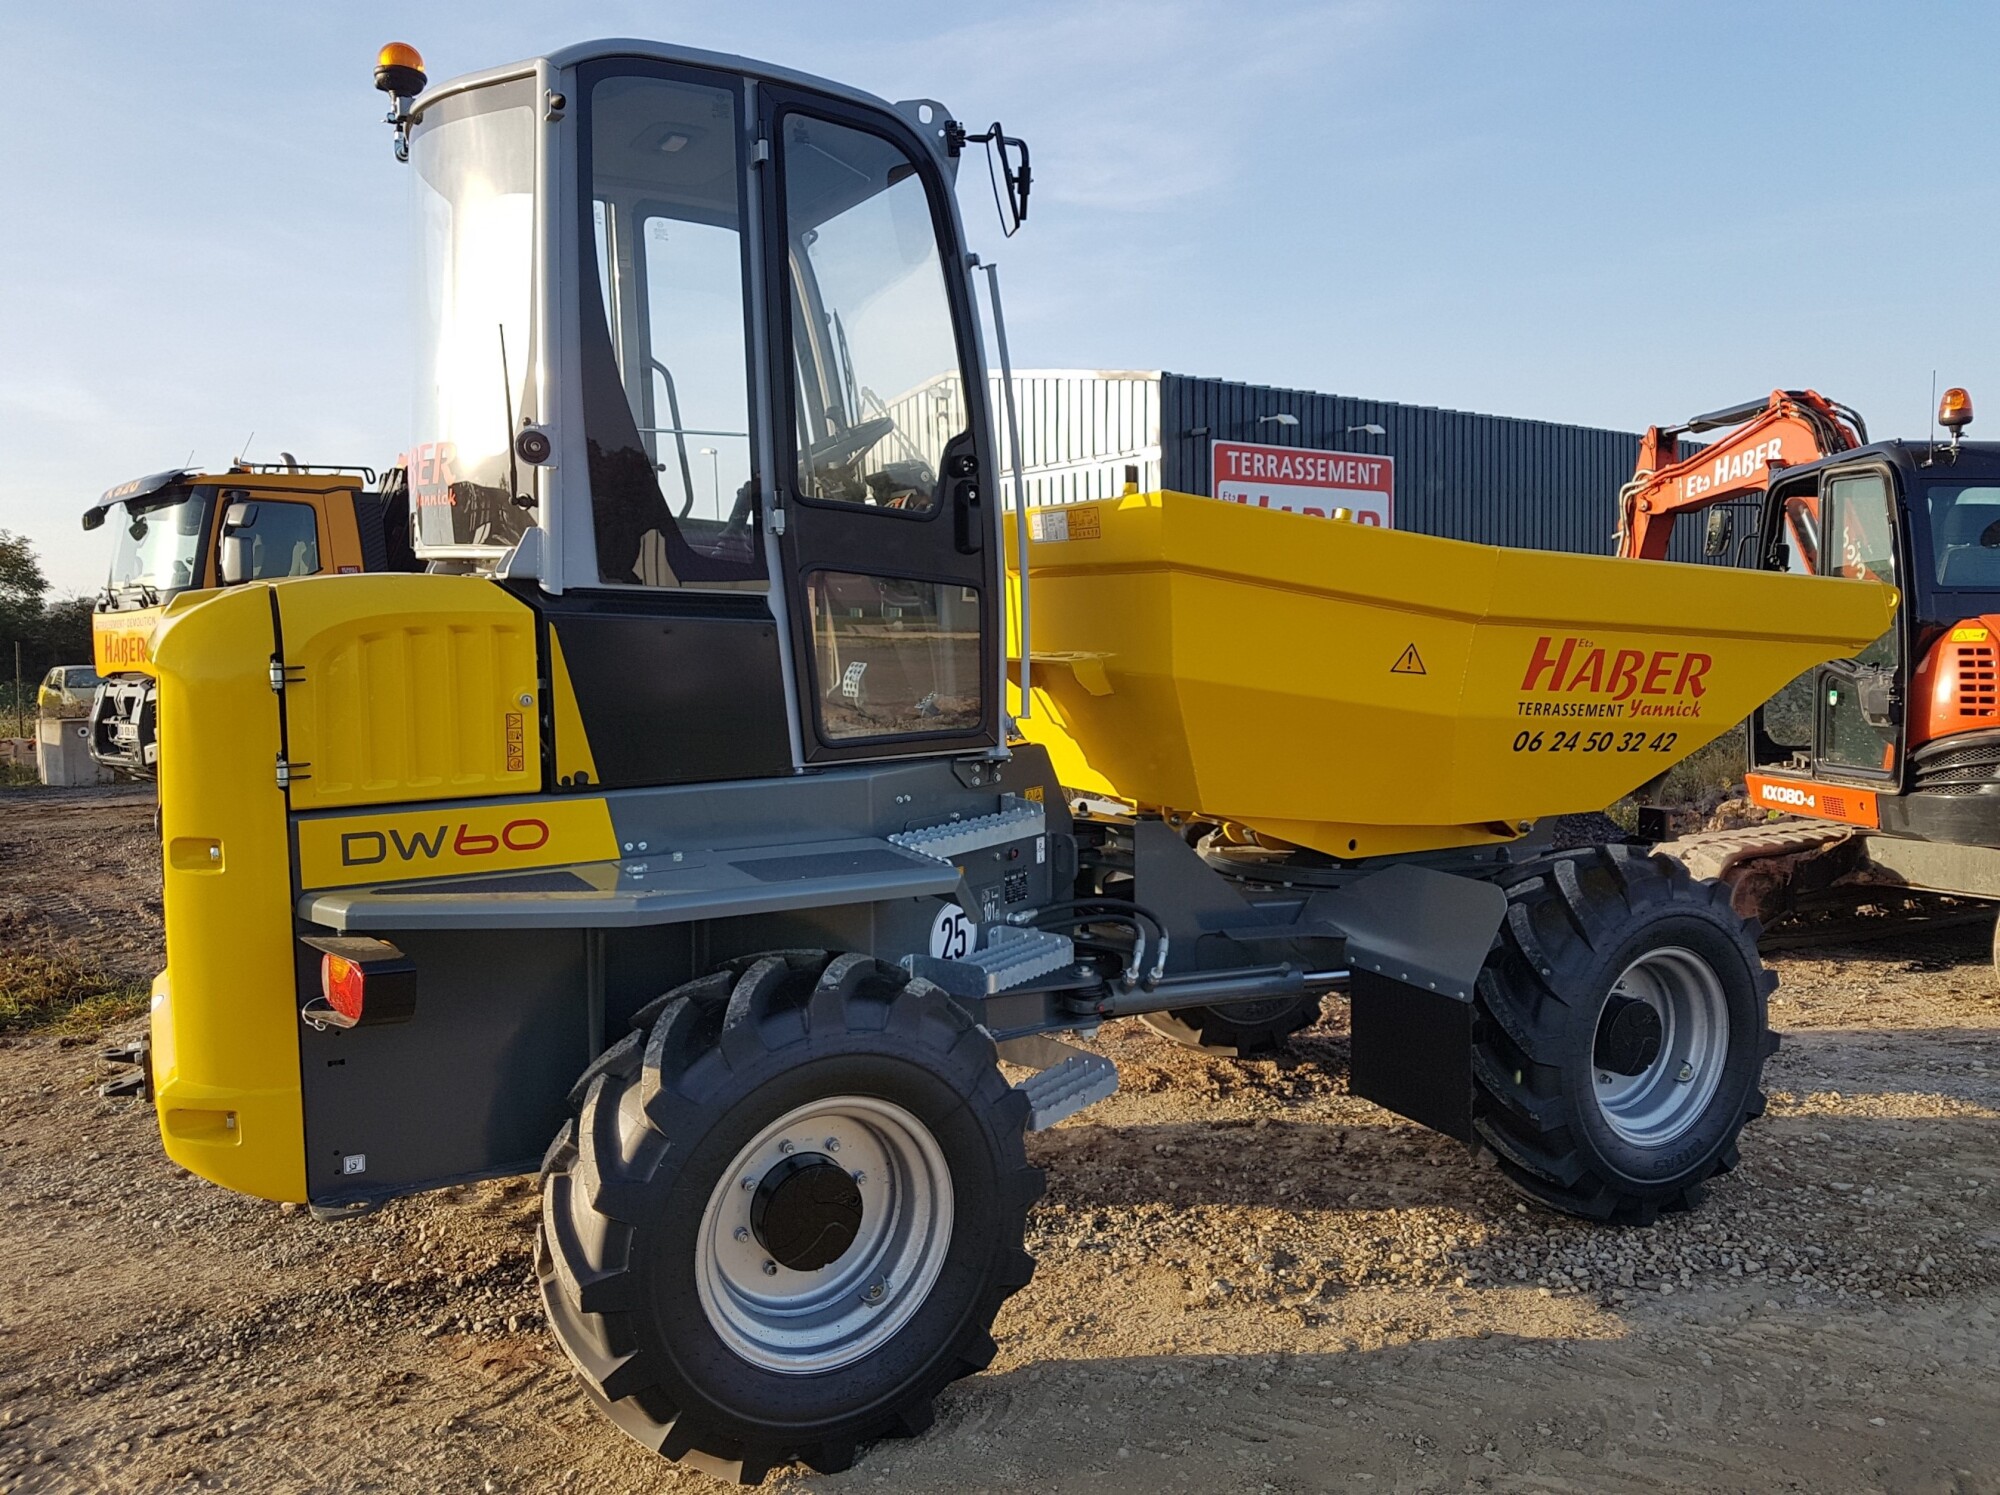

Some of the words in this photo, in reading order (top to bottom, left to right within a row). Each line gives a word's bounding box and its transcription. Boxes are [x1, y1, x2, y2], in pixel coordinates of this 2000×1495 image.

[1227, 451, 1381, 485] TERRASSEMENT
[1686, 475, 1710, 498] Ets
[1714, 438, 1782, 487] HABER
[105, 634, 146, 667] HABER
[1578, 638, 1594, 648] Ets
[1520, 636, 1712, 701] HABER
[1518, 702, 1625, 718] TERRASSEMENT
[1627, 699, 1702, 719] Yannick
[1513, 731, 1544, 752] 06
[1548, 731, 1581, 752] 24
[1583, 732, 1615, 752] 50
[1616, 732, 1646, 752] 32
[1648, 732, 1678, 752] 42
[1762, 784, 1816, 808] KX080-4
[341, 819, 550, 867] DW60
[941, 913, 967, 960] 25
